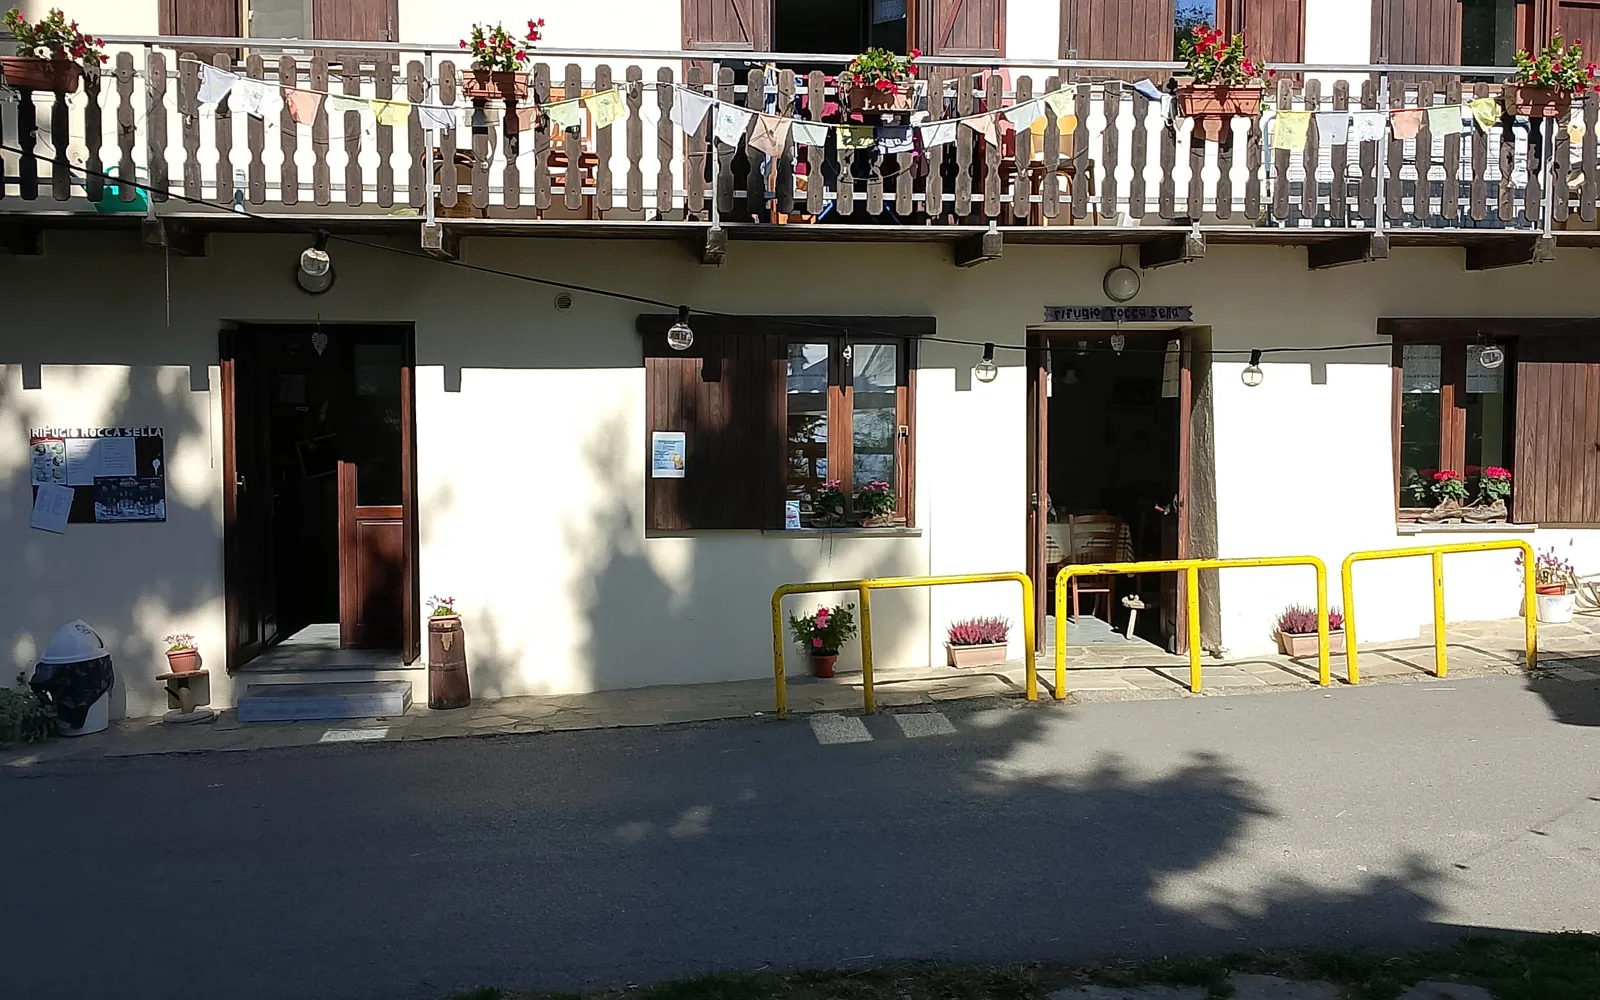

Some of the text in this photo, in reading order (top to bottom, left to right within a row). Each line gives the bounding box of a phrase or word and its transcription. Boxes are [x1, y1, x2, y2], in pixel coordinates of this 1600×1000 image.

[1054, 308, 1101, 320] rifugio
[81, 427, 121, 438] ROCCA
[124, 427, 162, 438] SELLA
